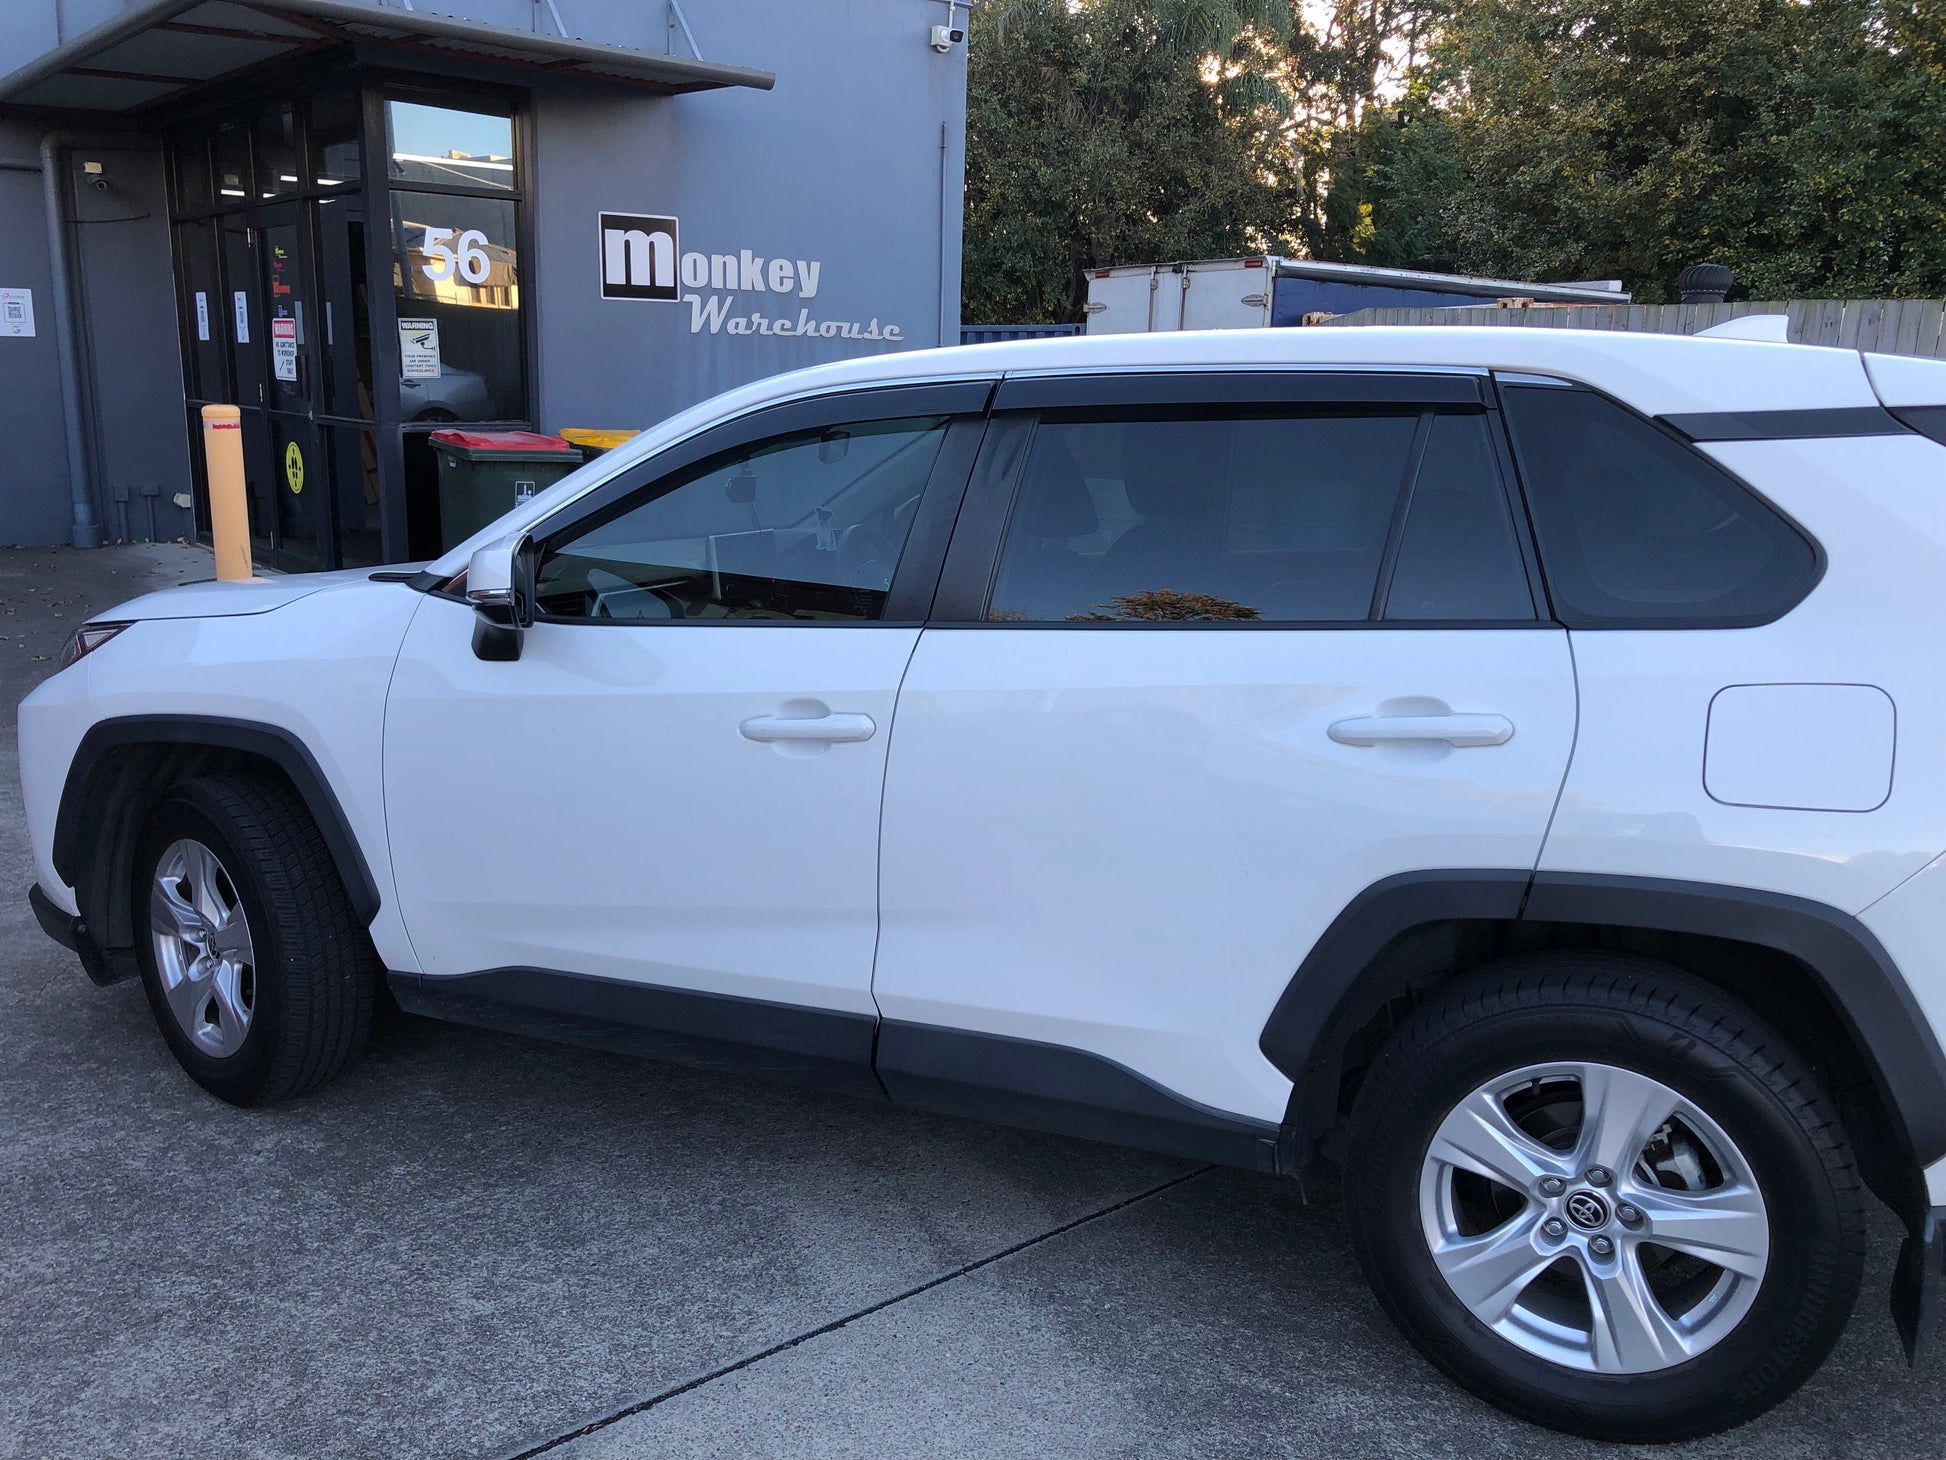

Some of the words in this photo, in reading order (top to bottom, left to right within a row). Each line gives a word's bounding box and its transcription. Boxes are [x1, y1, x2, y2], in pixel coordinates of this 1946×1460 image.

[422, 227, 491, 284] 56
[401, 321, 434, 330] WARNING
[682, 294, 904, 341] Warehouse
